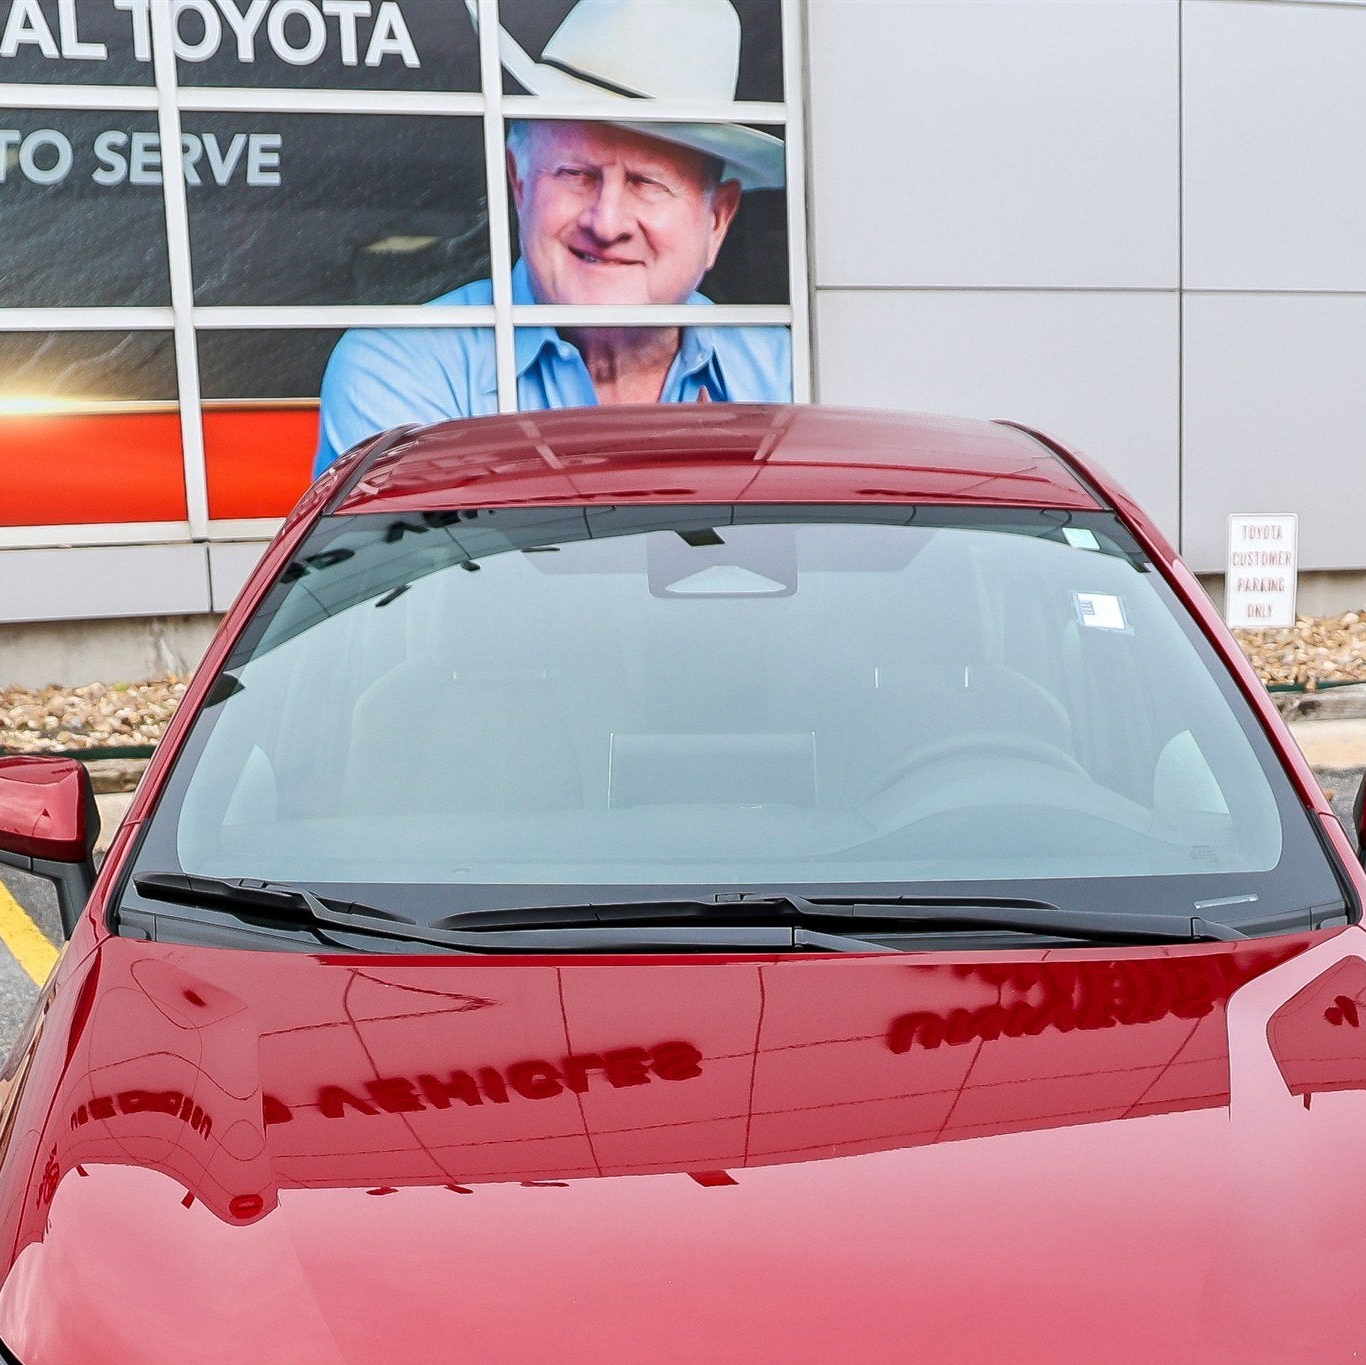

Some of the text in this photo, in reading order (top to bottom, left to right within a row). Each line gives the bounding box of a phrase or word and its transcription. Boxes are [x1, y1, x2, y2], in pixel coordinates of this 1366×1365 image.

[113, 0, 422, 68] TOYOTA
[91, 129, 283, 188] SERVE
[1242, 524, 1284, 540] TOYOTA
[1232, 550, 1292, 567] CUSTOMER
[1237, 576, 1285, 592] PARKING
[1246, 602, 1274, 618] ONLY
